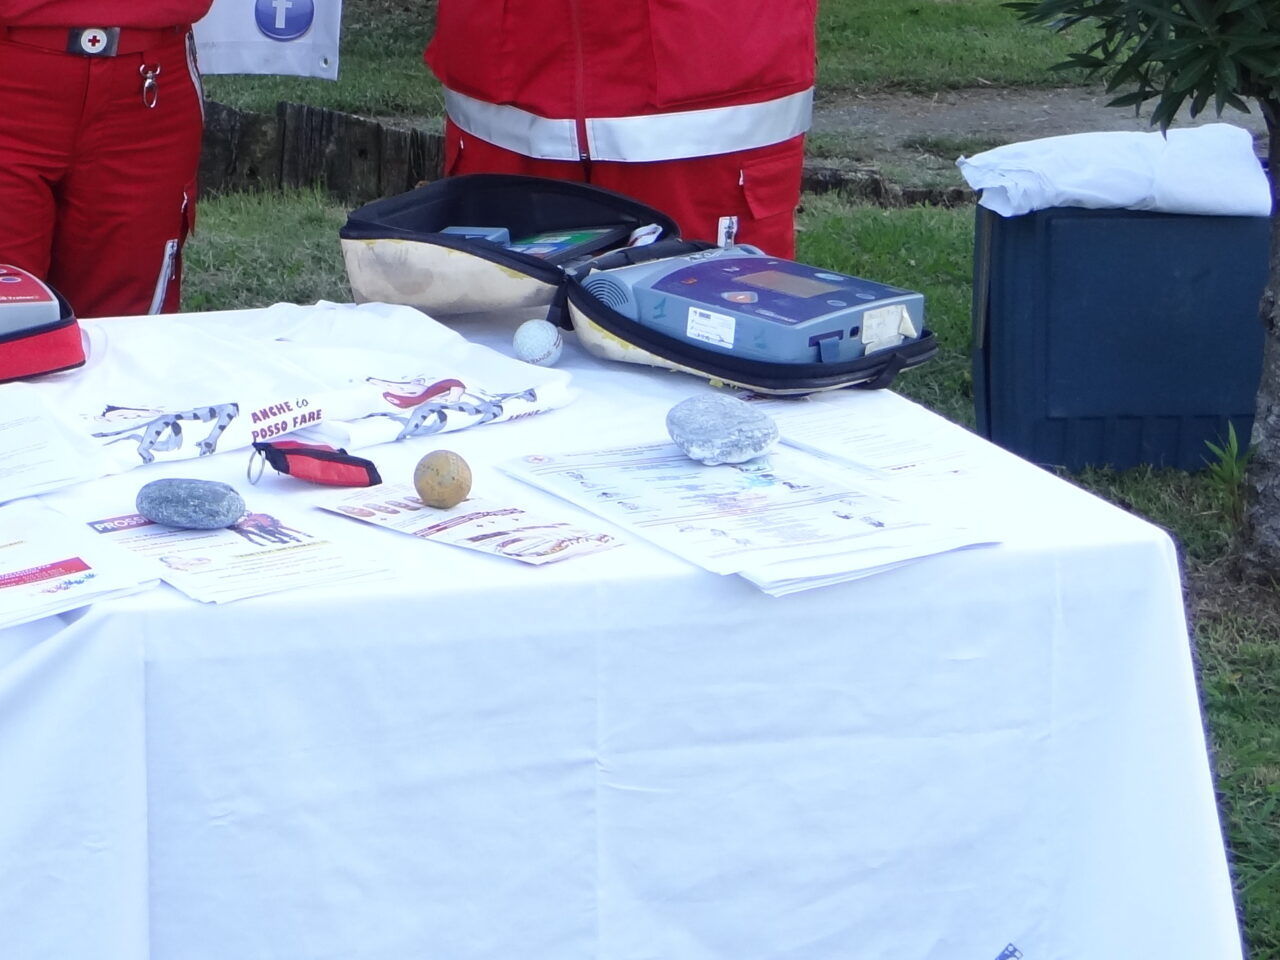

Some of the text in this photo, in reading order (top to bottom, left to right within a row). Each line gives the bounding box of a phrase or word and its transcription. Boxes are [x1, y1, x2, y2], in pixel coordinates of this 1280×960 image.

[251, 398, 309, 424] ANCHE io
[251, 409, 322, 443] POSSO FARE
[94, 517, 145, 531] PROSS
